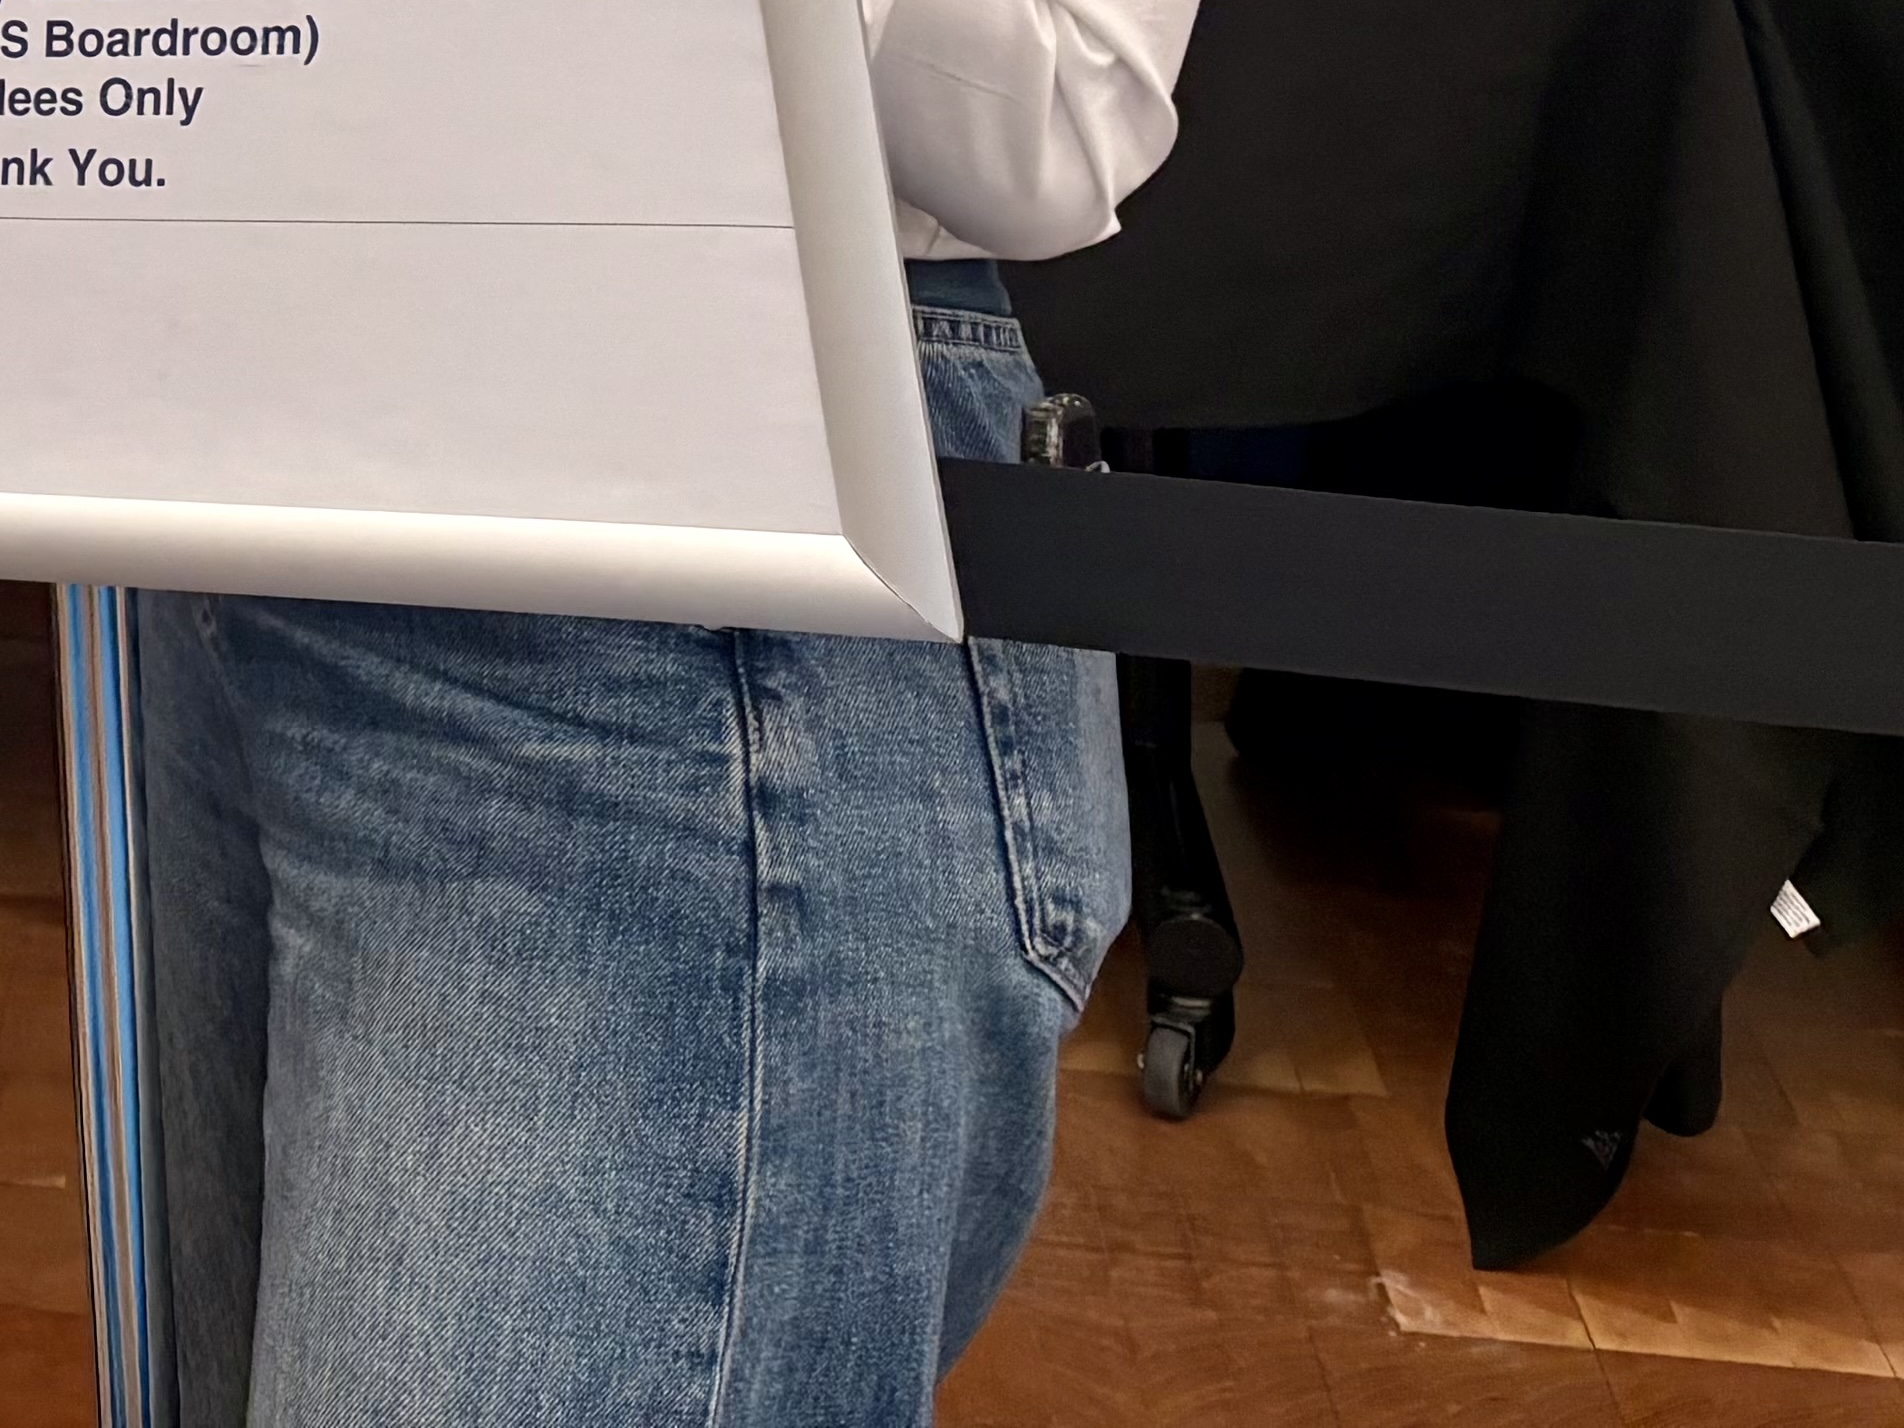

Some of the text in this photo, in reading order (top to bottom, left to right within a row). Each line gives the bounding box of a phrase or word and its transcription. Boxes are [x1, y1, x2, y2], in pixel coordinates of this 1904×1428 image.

[44, 14, 320, 67] Boardroom)
[98, 76, 206, 127] Only
[67, 147, 166, 188] You.
